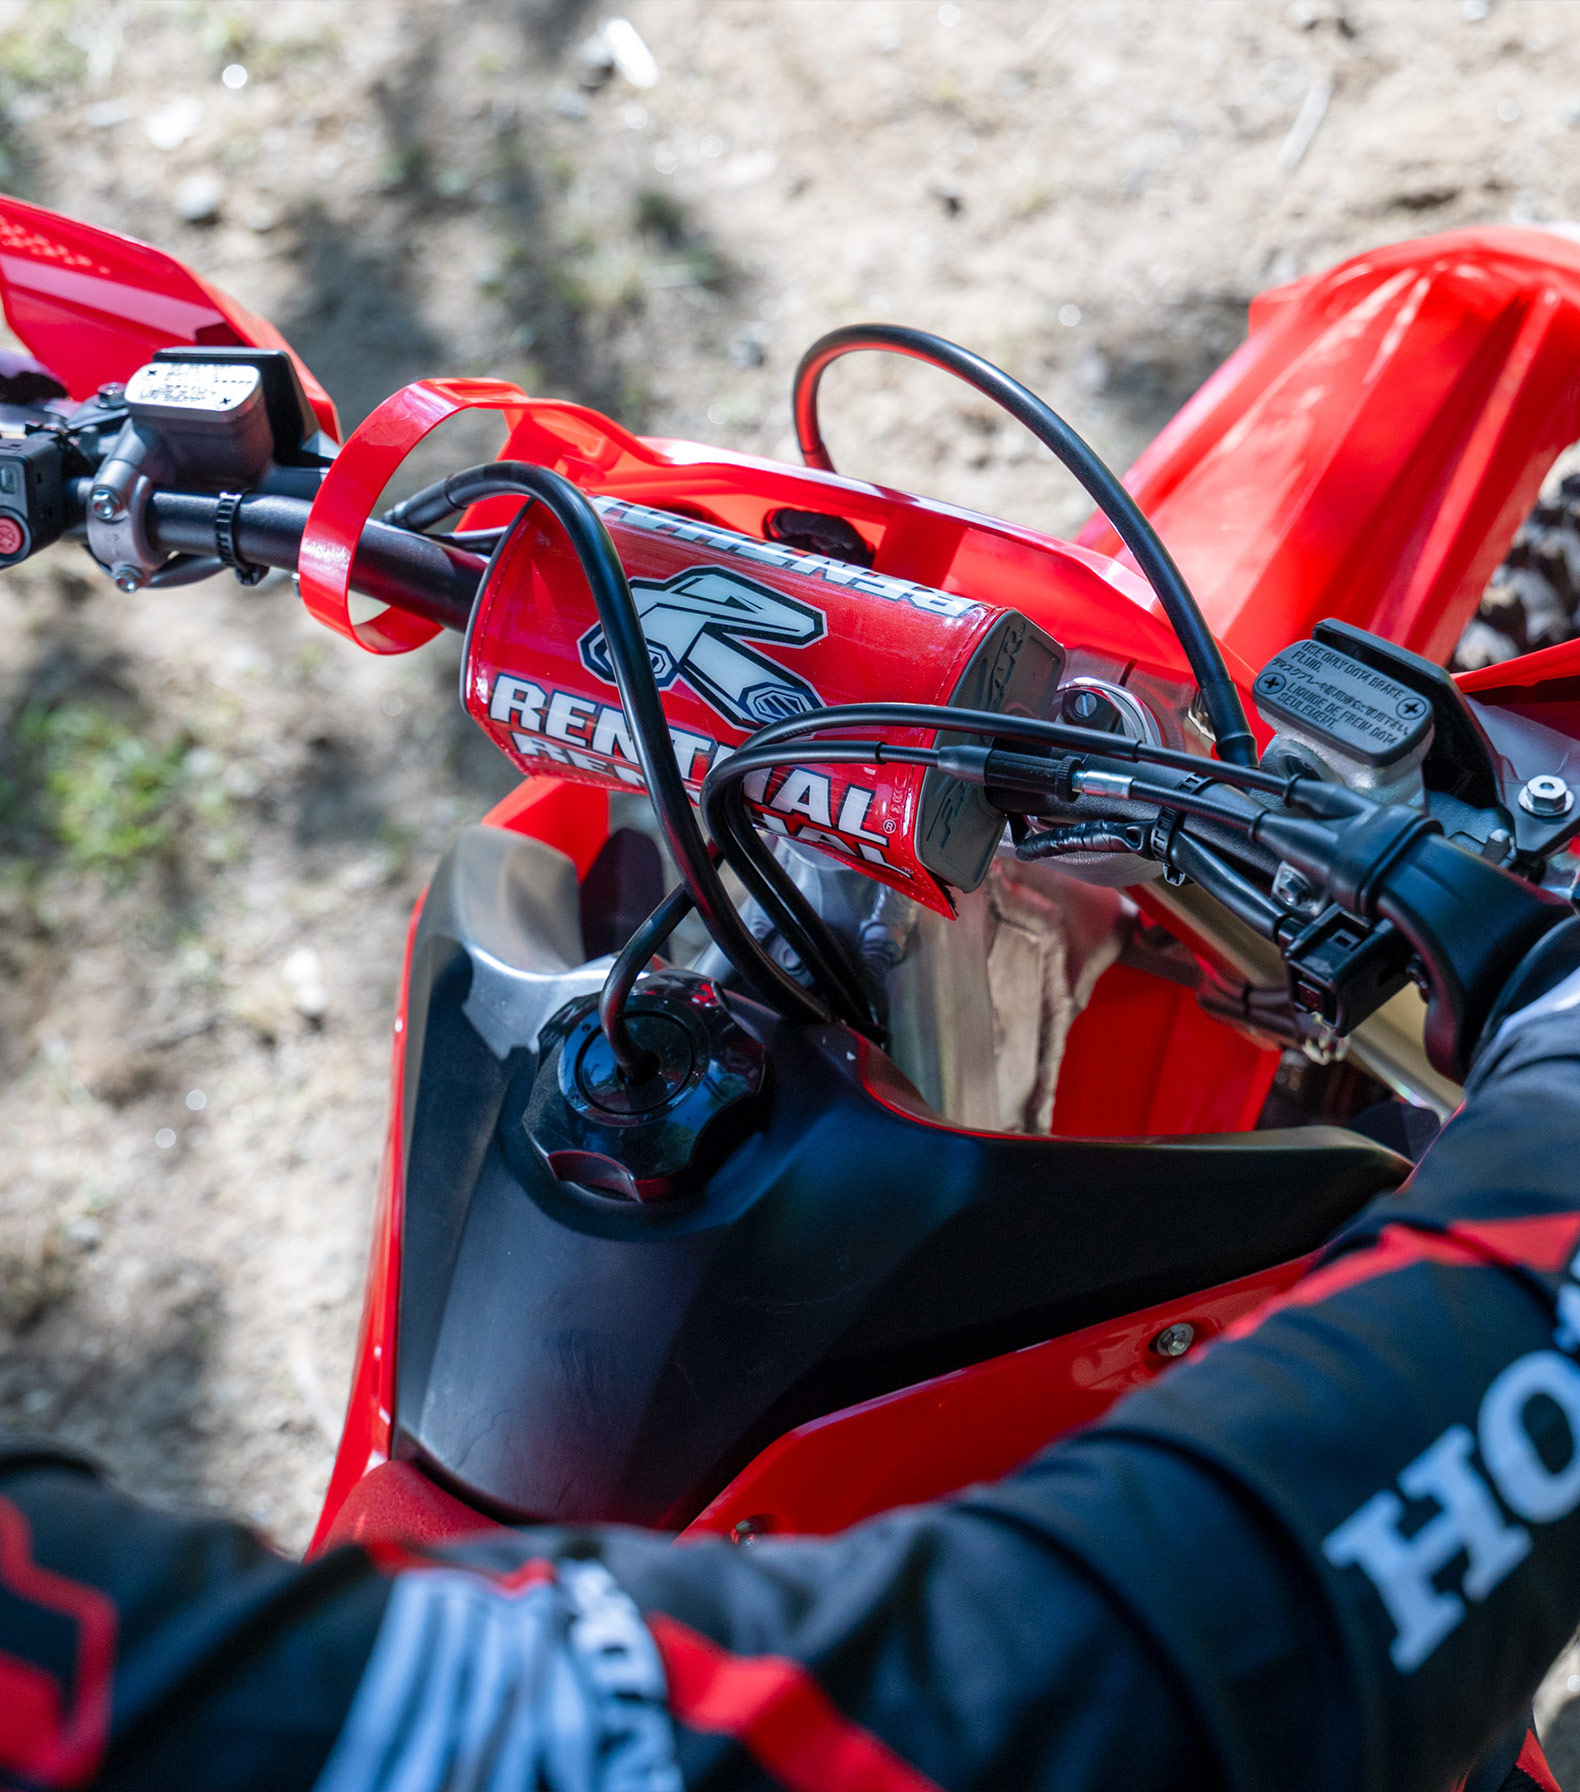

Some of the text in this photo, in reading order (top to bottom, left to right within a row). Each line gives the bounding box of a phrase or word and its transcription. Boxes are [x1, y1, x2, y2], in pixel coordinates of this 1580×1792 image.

[1291, 650, 1322, 673] FLUID.
[1301, 641, 1405, 700] USE ONLY DOT4 BRAKE
[1277, 692, 1338, 729] SEULEMENT.
[1286, 682, 1397, 745] LIQUIDE DE FREIN DOT4
[1322, 1248, 1580, 1673] HO
